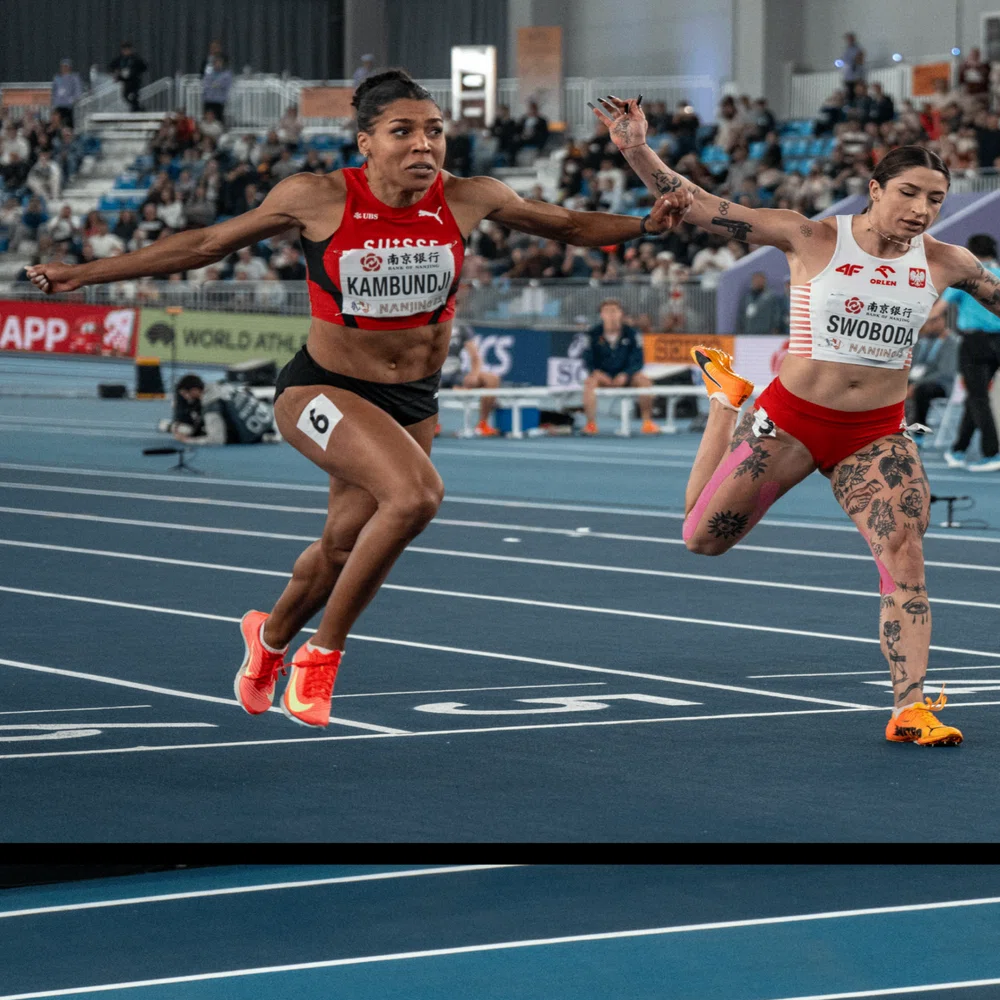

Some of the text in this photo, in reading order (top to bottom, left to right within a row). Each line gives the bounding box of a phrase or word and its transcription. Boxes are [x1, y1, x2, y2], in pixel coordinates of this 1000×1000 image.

[387, 251, 440, 266] 南京银行
[835, 263, 864, 277] 4F
[347, 270, 452, 298] KAMBUNDJI
[870, 278, 897, 286] ORLEN
[867, 301, 913, 318] 南京银行
[0, 315, 68, 350] APP
[183, 328, 249, 351] WORLD
[826, 314, 914, 346] SWOBODA
[310, 408, 329, 434] 6
